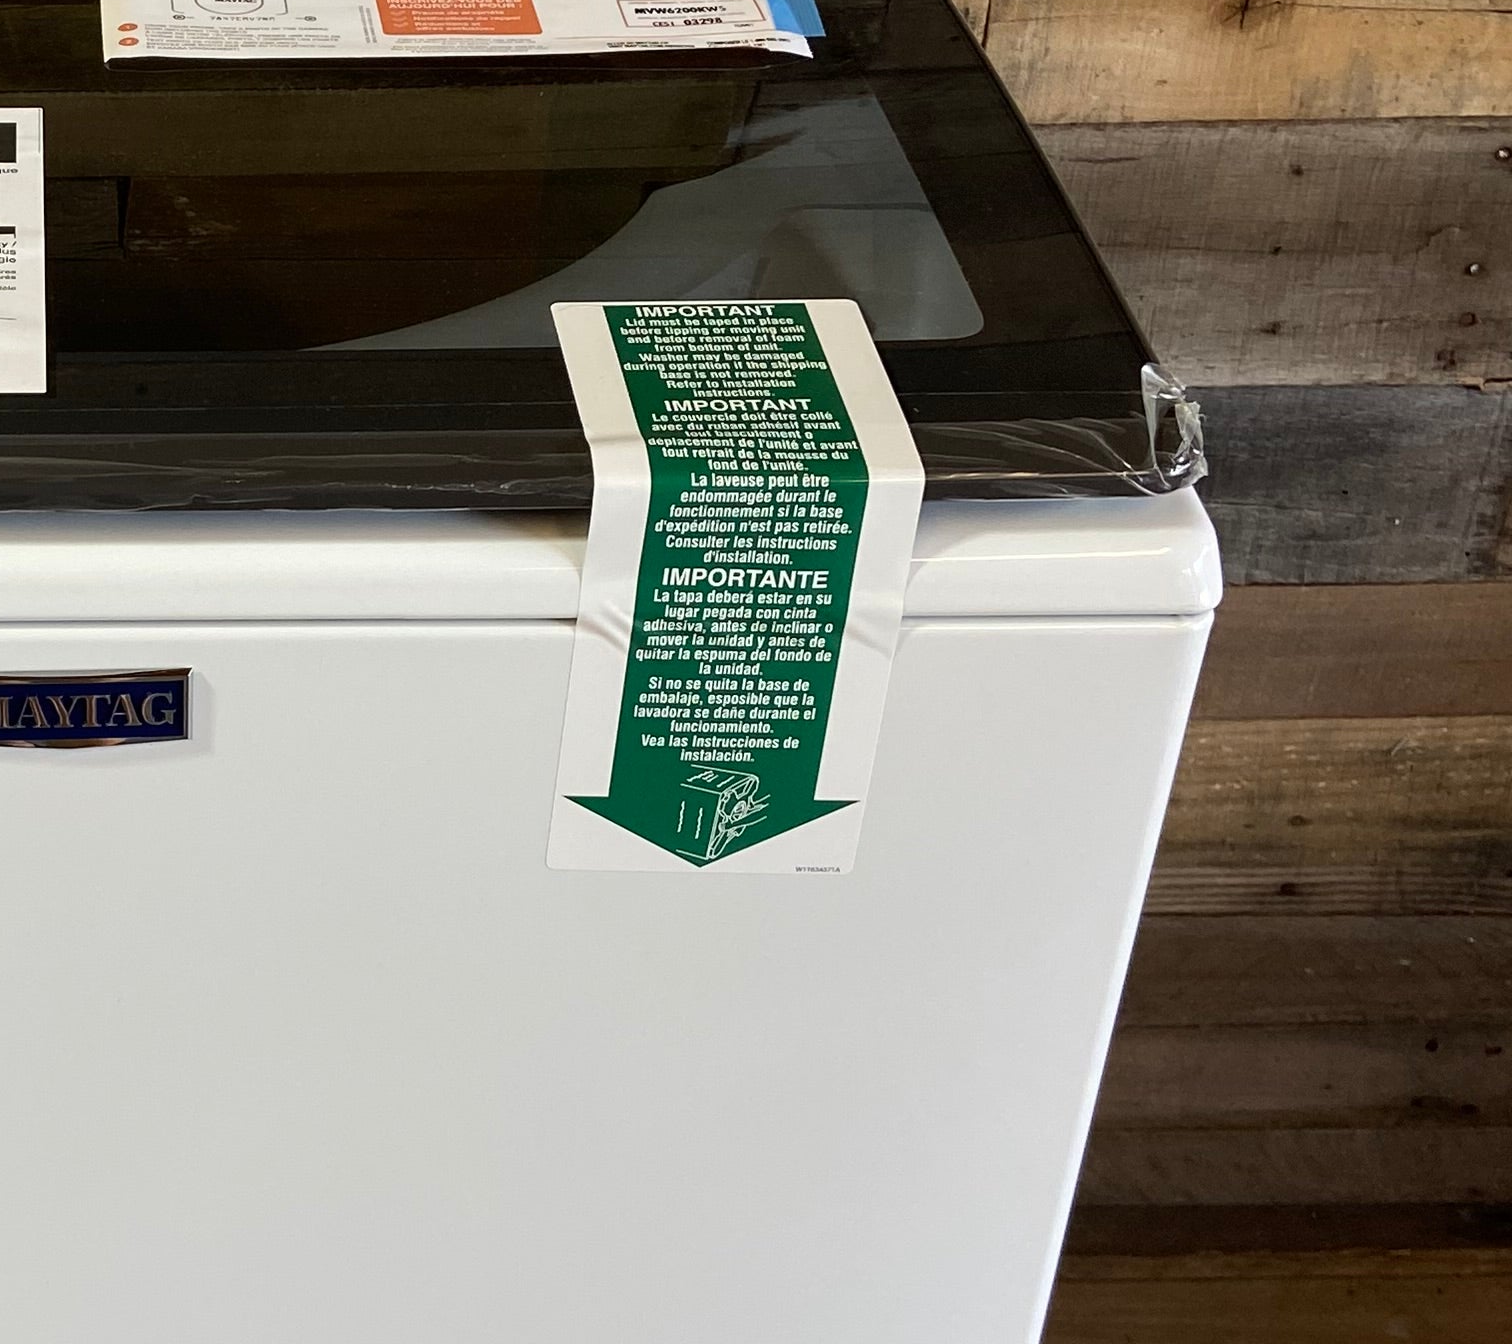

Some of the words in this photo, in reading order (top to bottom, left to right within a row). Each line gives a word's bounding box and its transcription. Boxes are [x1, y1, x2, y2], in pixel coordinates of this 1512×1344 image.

[682, 17, 724, 26] 03298
[635, 305, 777, 318] IMPORTANT
[663, 398, 812, 413] IMPORTANT
[690, 472, 708, 488] La
[710, 472, 766, 488] laveuse
[768, 473, 800, 490] peut
[802, 472, 830, 488] être
[679, 488, 774, 506] endommagée
[775, 489, 821, 504] durant
[822, 489, 837, 504] le
[668, 503, 775, 519] fonctionnement
[777, 504, 791, 519] si
[792, 504, 807, 519] la
[808, 505, 844, 519] base
[654, 519, 736, 537] d'expédition
[738, 519, 773, 534] n'est
[774, 522, 801, 537] pas
[802, 520, 853, 535] retirée.
[703, 550, 794, 565] d'installation.
[661, 567, 830, 590] IMPORTANTE
[653, 590, 670, 603] La
[672, 592, 704, 606] tapa
[706, 590, 754, 605] deberá
[756, 592, 794, 605] estar
[795, 594, 813, 605] en
[815, 594, 832, 606] su
[664, 605, 701, 621] lugar
[702, 605, 753, 621] pegada
[755, 608, 781, 619] con
[783, 606, 818, 620] cinta
[669, 719, 775, 734] funcionamiento.
[679, 748, 755, 763] instalación.
